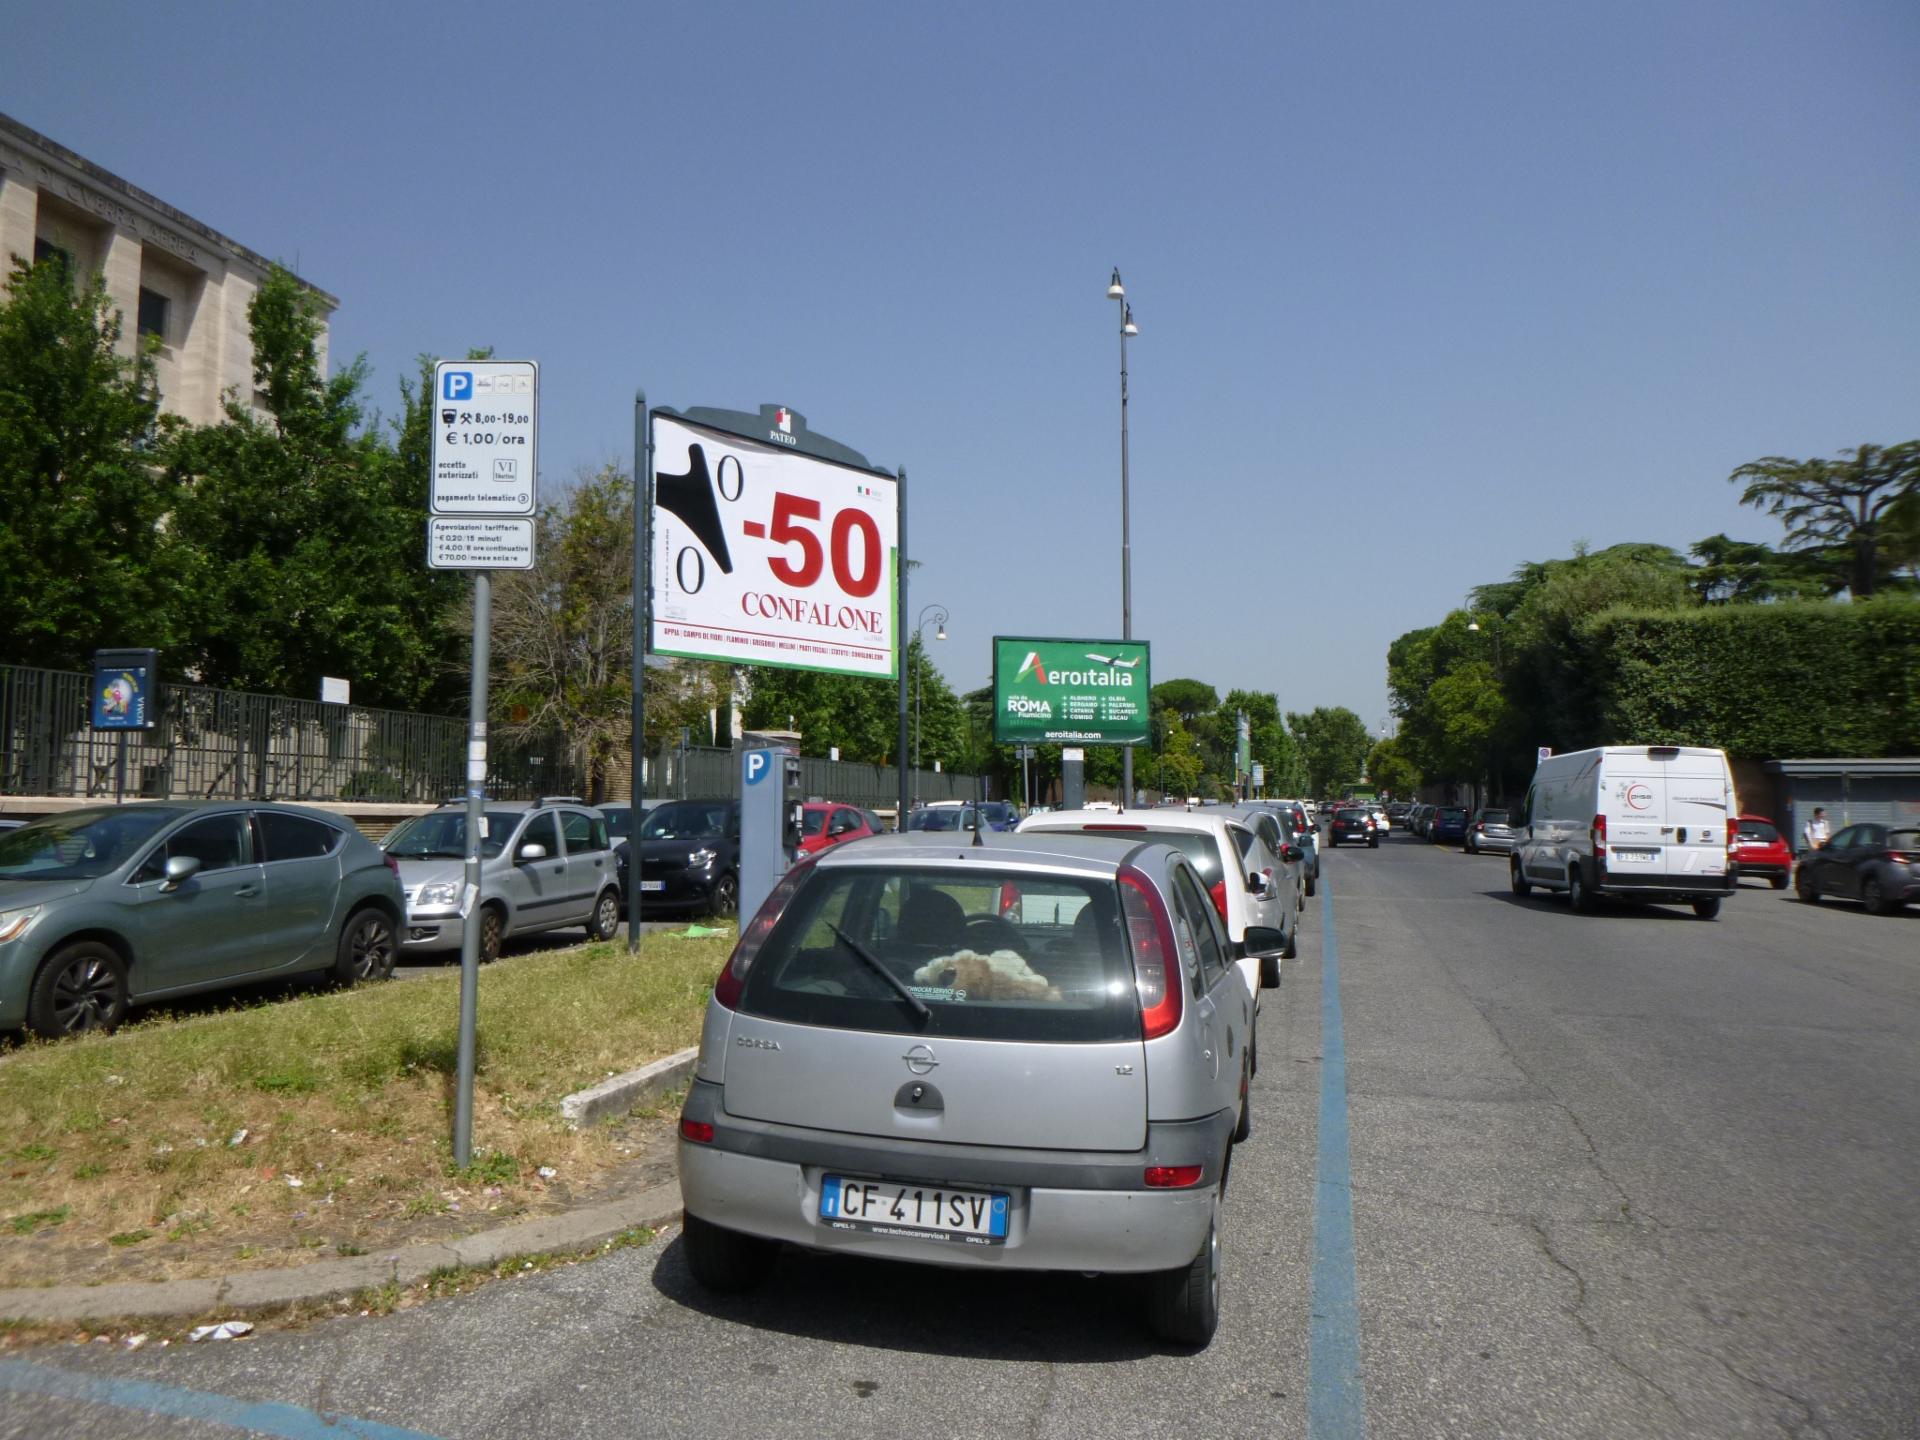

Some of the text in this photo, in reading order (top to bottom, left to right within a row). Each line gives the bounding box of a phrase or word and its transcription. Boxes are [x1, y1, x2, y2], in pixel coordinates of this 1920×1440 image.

[449, 374, 468, 398] P
[770, 430, 797, 446] PATEO
[438, 471, 479, 480] autorizzati
[437, 493, 476, 503] pagamento
[477, 493, 516, 502] telematico
[743, 491, 882, 598] -50
[741, 591, 883, 634] CONFALONE
[683, 630, 702, 639] CAMPO
[1007, 700, 1052, 713] ROMA
[1044, 730, 1102, 740] aeroitalia.com
[748, 753, 764, 779] P
[736, 1036, 782, 1052] CORSA
[843, 1183, 986, 1230] CF 411SV
[832, 1222, 851, 1230] OPEL
[965, 1236, 985, 1245] OPEL
